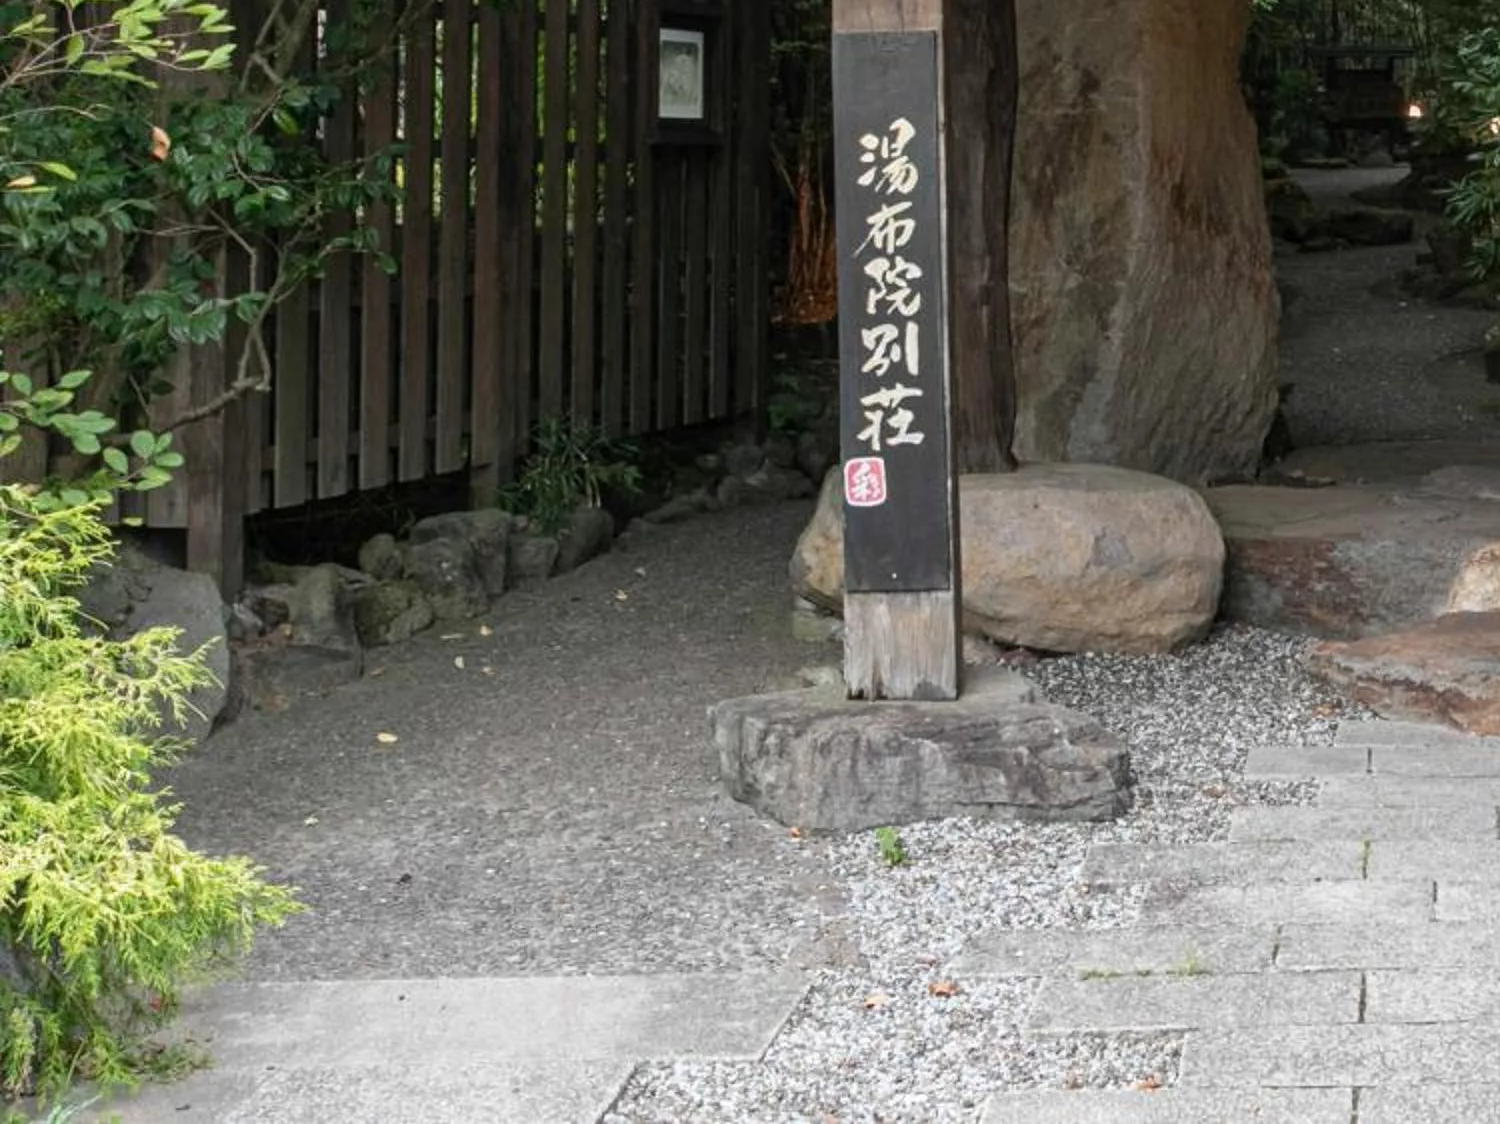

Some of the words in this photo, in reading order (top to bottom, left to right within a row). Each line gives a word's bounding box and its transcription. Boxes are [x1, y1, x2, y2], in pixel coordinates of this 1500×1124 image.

[854, 117, 925, 452] 湯布院別荘
